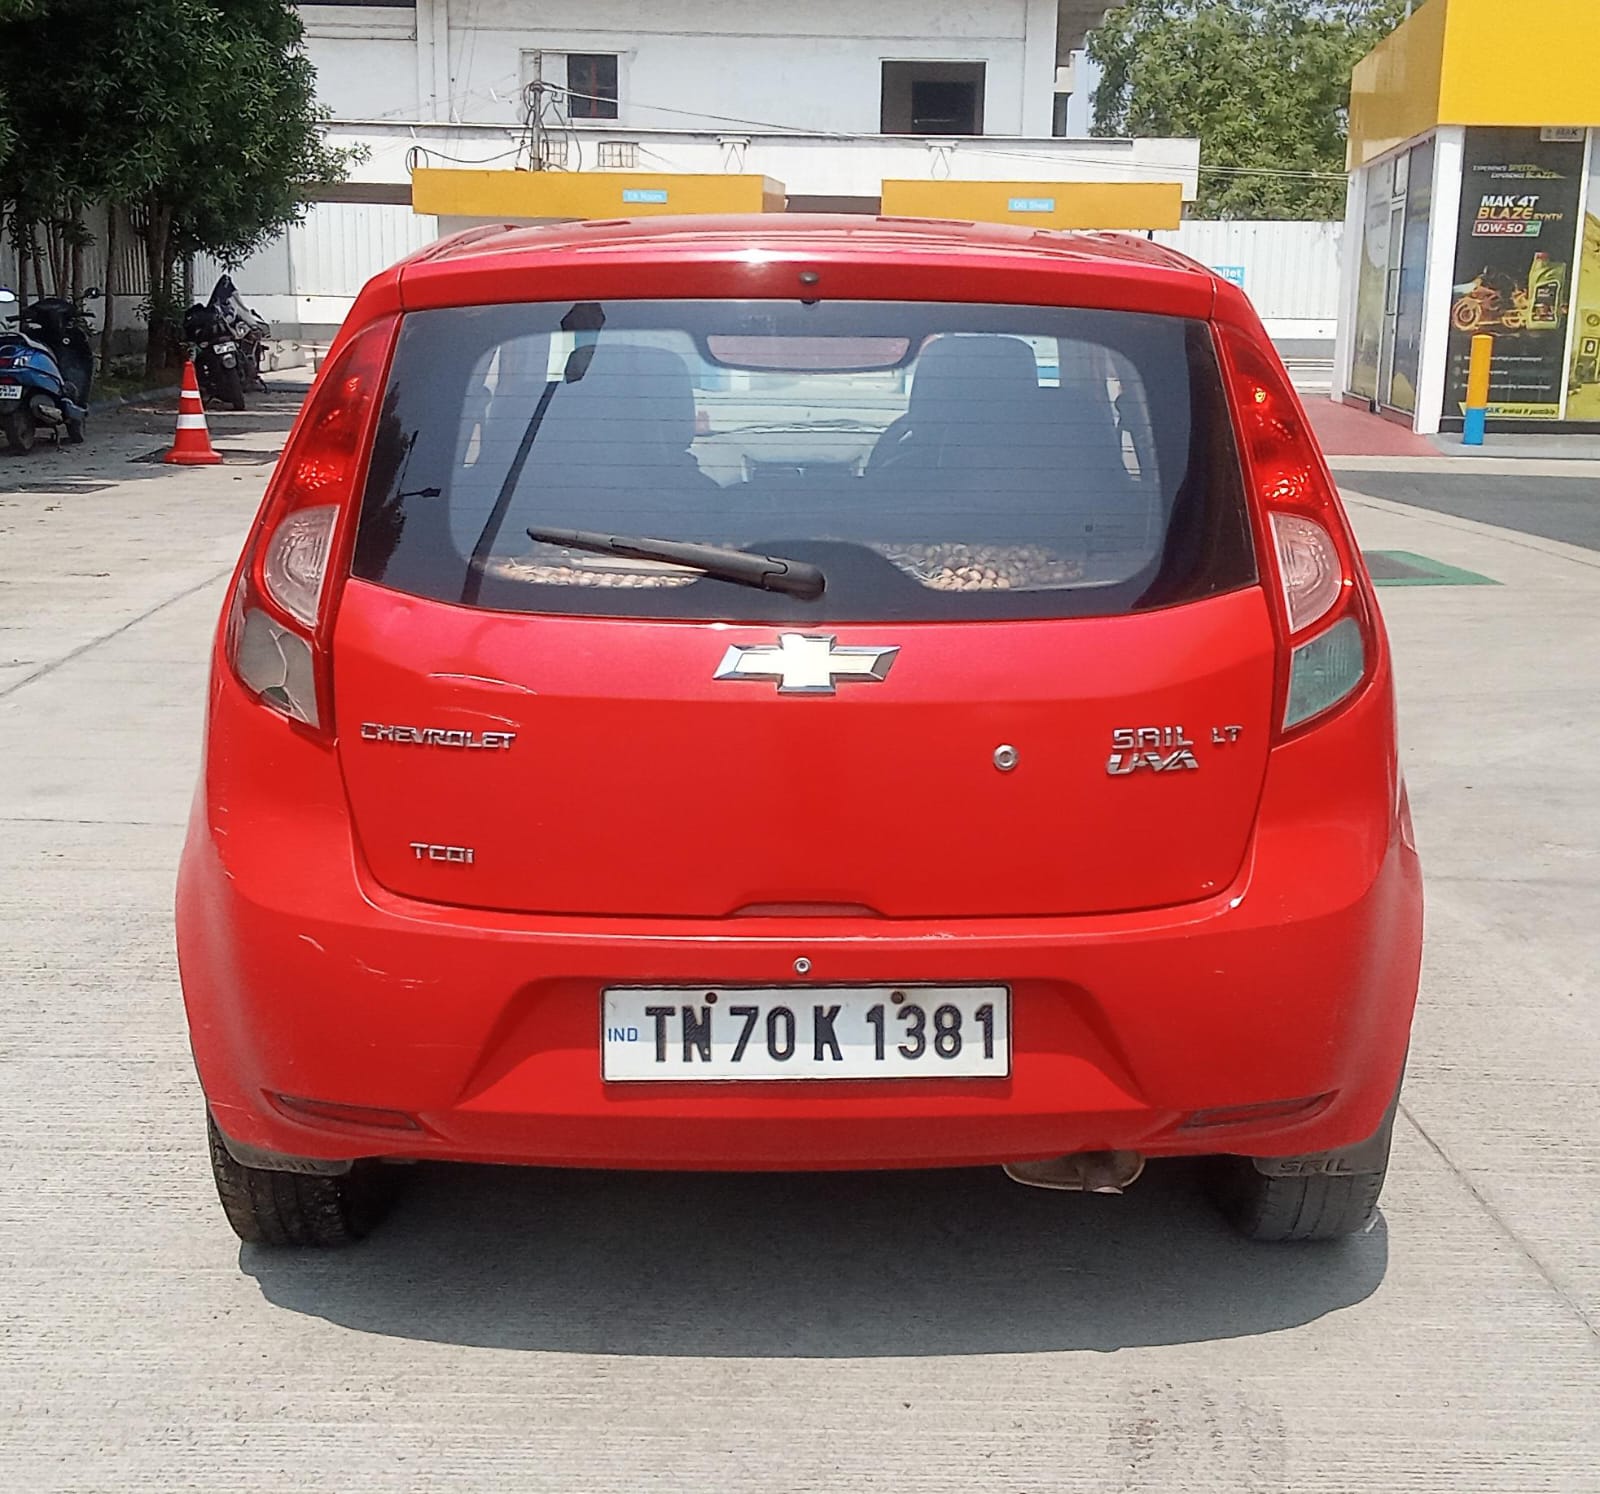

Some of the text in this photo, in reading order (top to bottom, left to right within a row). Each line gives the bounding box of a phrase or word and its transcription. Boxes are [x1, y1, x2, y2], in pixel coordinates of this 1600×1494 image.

[1480, 195, 1539, 207] MAK 4T
[1477, 207, 1564, 221] BLAZE SYNTH
[1476, 223, 1523, 233] 10W-50
[361, 722, 516, 749] CHEVROLET
[1112, 725, 1243, 749] SAIL LT
[1107, 749, 1199, 775] UVA
[608, 1003, 994, 1063] IND TN 70 K 1381
[1279, 1158, 1352, 1173] SAIL
